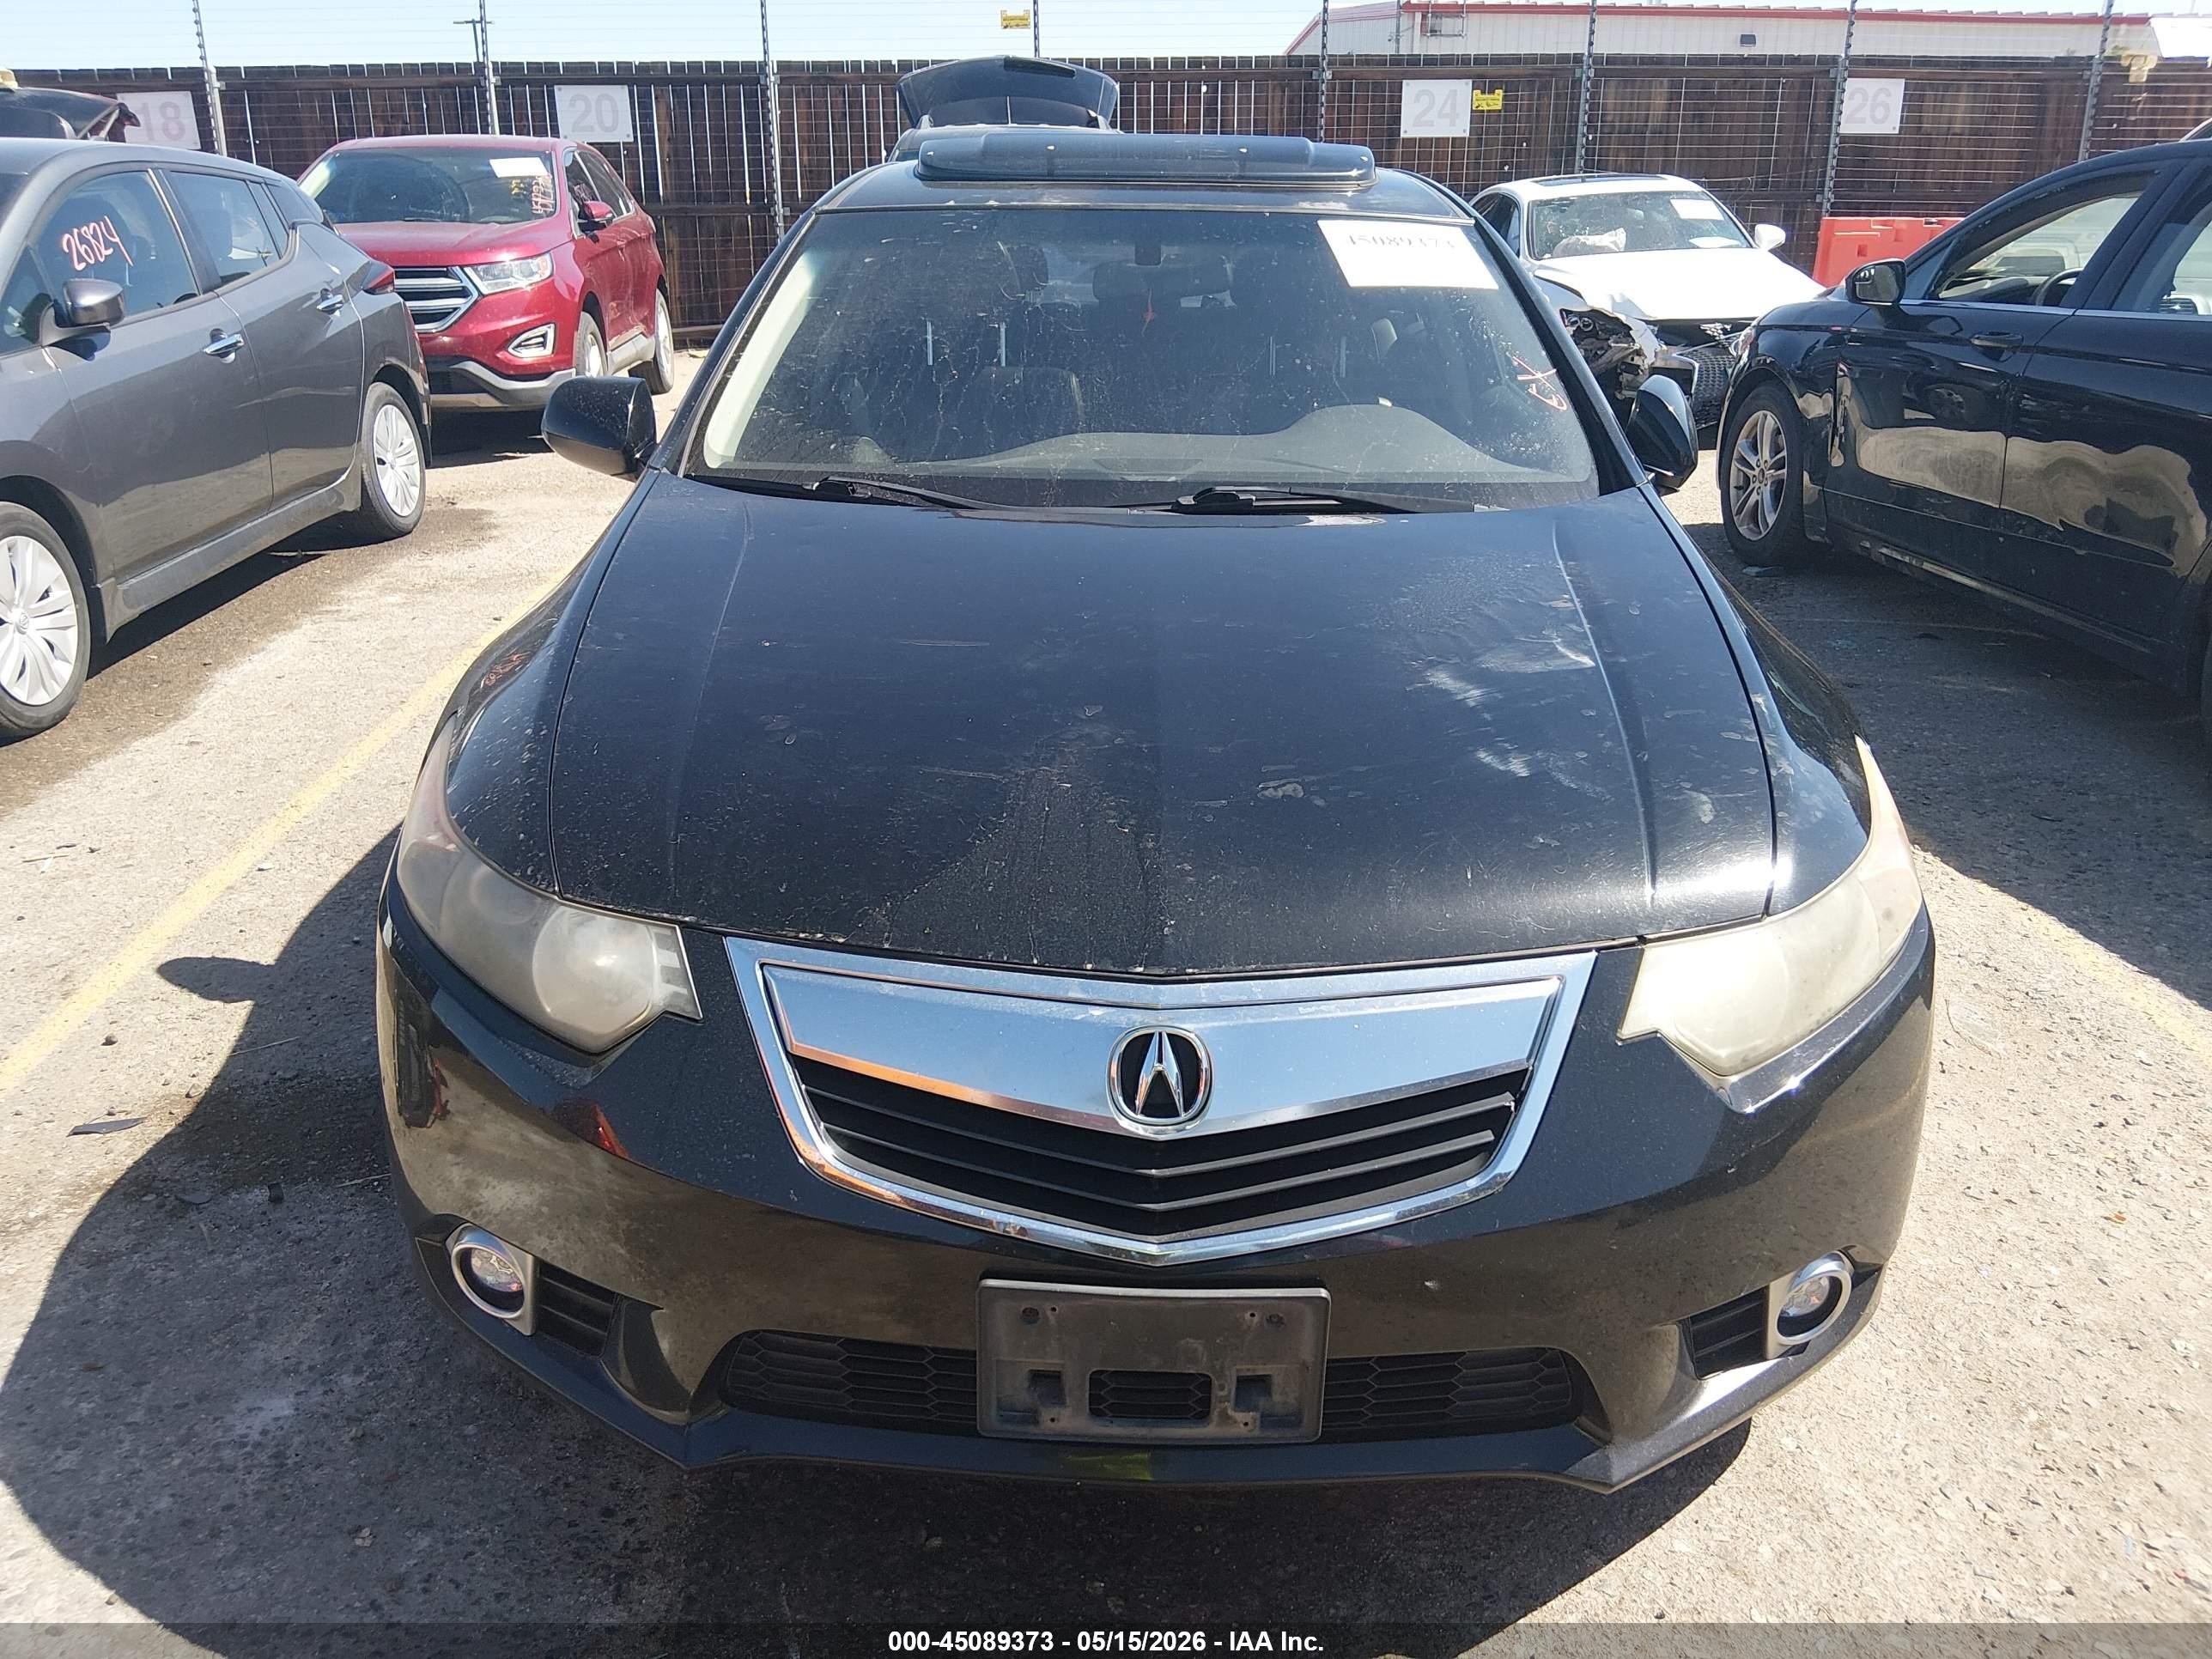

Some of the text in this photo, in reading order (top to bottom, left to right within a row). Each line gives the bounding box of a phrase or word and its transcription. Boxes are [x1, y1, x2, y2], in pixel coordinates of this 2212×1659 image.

[136, 101, 186, 143] 18
[568, 93, 619, 132] 20
[1413, 88, 1460, 127] 24
[1844, 88, 1893, 125] 26
[62, 215, 134, 270] 26824
